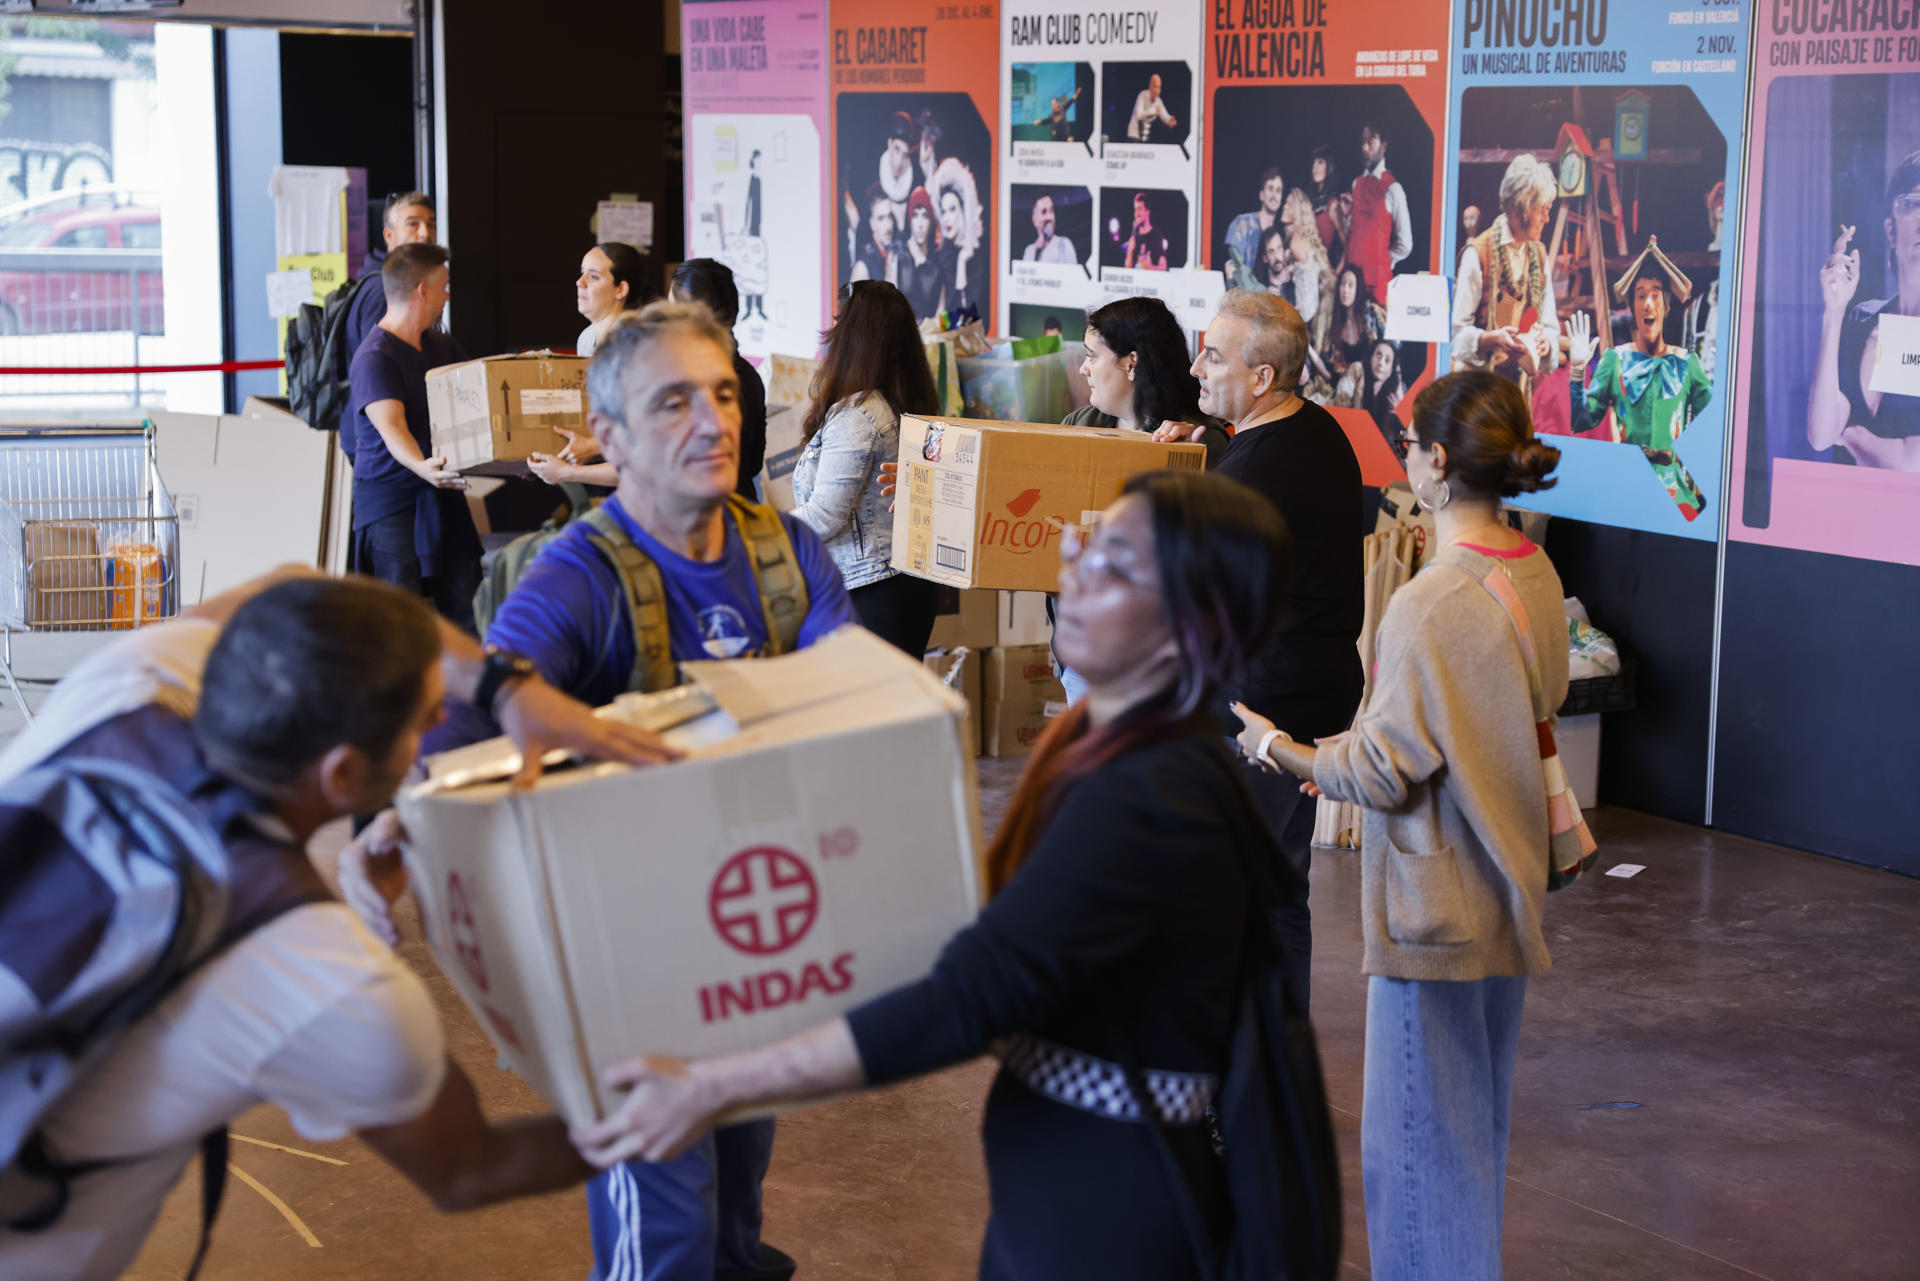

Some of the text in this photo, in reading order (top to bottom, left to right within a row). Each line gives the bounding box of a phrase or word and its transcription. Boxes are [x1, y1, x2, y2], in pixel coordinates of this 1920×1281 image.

[740, 16, 765, 41] CABE
[1012, 11, 1158, 46] RAM CLUB COMEDY
[1215, 0, 1327, 30] EL AGUA DE
[1463, 0, 1608, 48] PINOCHO
[729, 45, 767, 72] MALETA
[835, 29, 851, 65] EL
[856, 27, 927, 64] CABARET
[1214, 31, 1325, 78] VALENCIA
[1697, 35, 1737, 54] 2 NOV.
[1770, 36, 1920, 66] CON PAISAJE DE FO
[1462, 50, 1627, 75] UN MUSICAL DE AVENTURAS
[311, 268, 335, 282] Club
[1407, 305, 1432, 317] COMIDA
[698, 950, 857, 1025] INDAS
